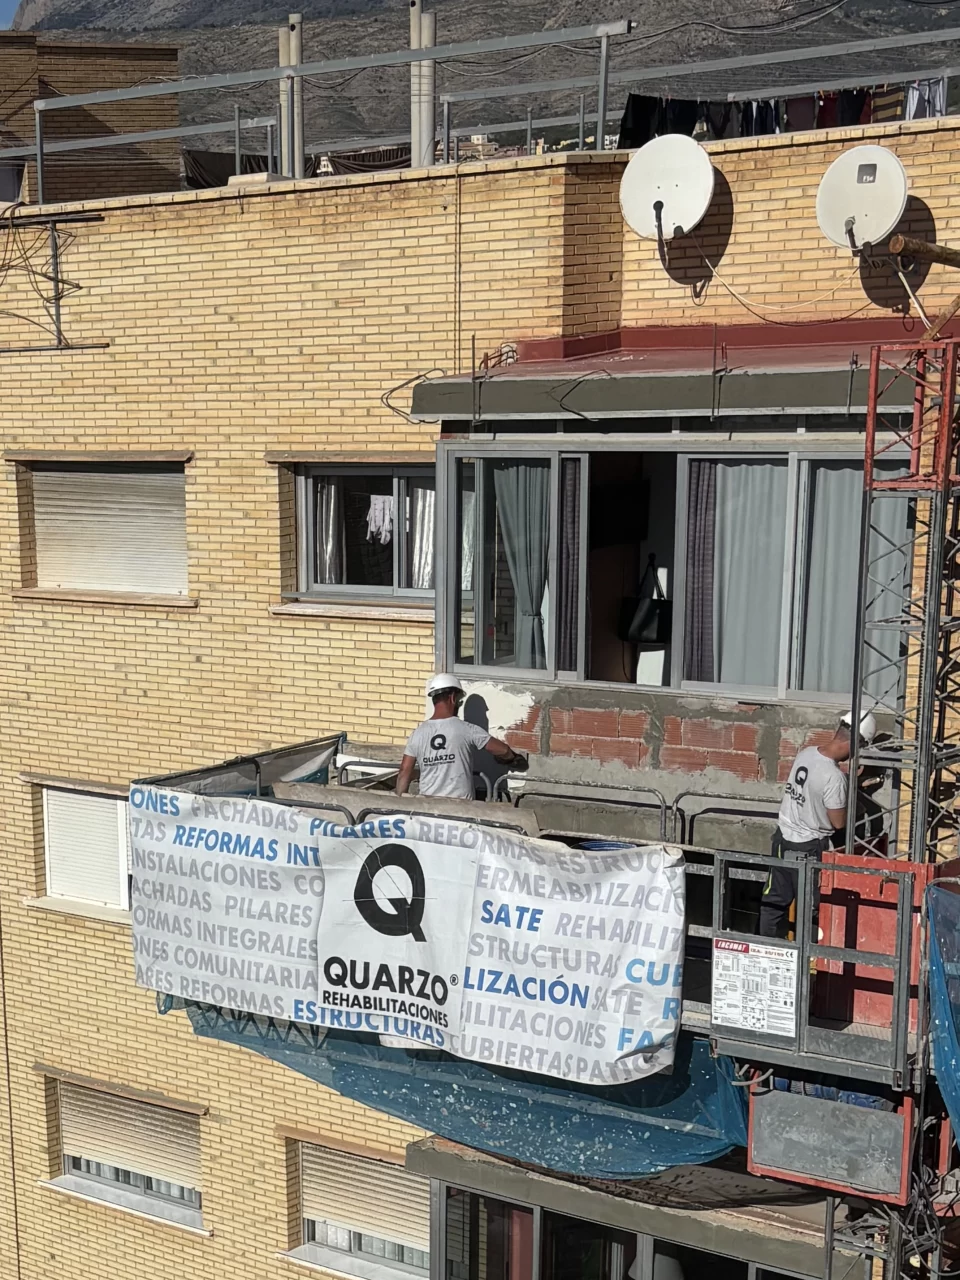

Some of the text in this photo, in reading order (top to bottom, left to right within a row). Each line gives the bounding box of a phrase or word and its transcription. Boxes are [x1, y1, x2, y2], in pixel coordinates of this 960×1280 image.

[430, 734, 446, 751] Q
[795, 766, 808, 789] Q
[130, 788, 180, 817] ONES
[191, 798, 299, 833] FACHADAS
[309, 817, 406, 839] PILARES
[419, 820, 546, 865] REFORMAS
[132, 817, 319, 867] TAS REFORMAS INT
[132, 877, 313, 929] ACHADAS PILARES
[294, 874, 324, 898] CO
[353, 843, 427, 942] Q
[133, 904, 318, 961] ORMAS INTEGRALES
[480, 899, 544, 932] SATE
[173, 945, 317, 991] COMUNITARIA
[468, 932, 621, 979] STRUCTURAS
[136, 964, 445, 1047] ARES REFORMAS ESTRUCTURAS
[322, 990, 449, 1028] REHABILITACIONES
[463, 966, 590, 1009] LIZACIÓN
[591, 985, 643, 1016] SATE
[460, 1003, 607, 1049] ILITACIONES
